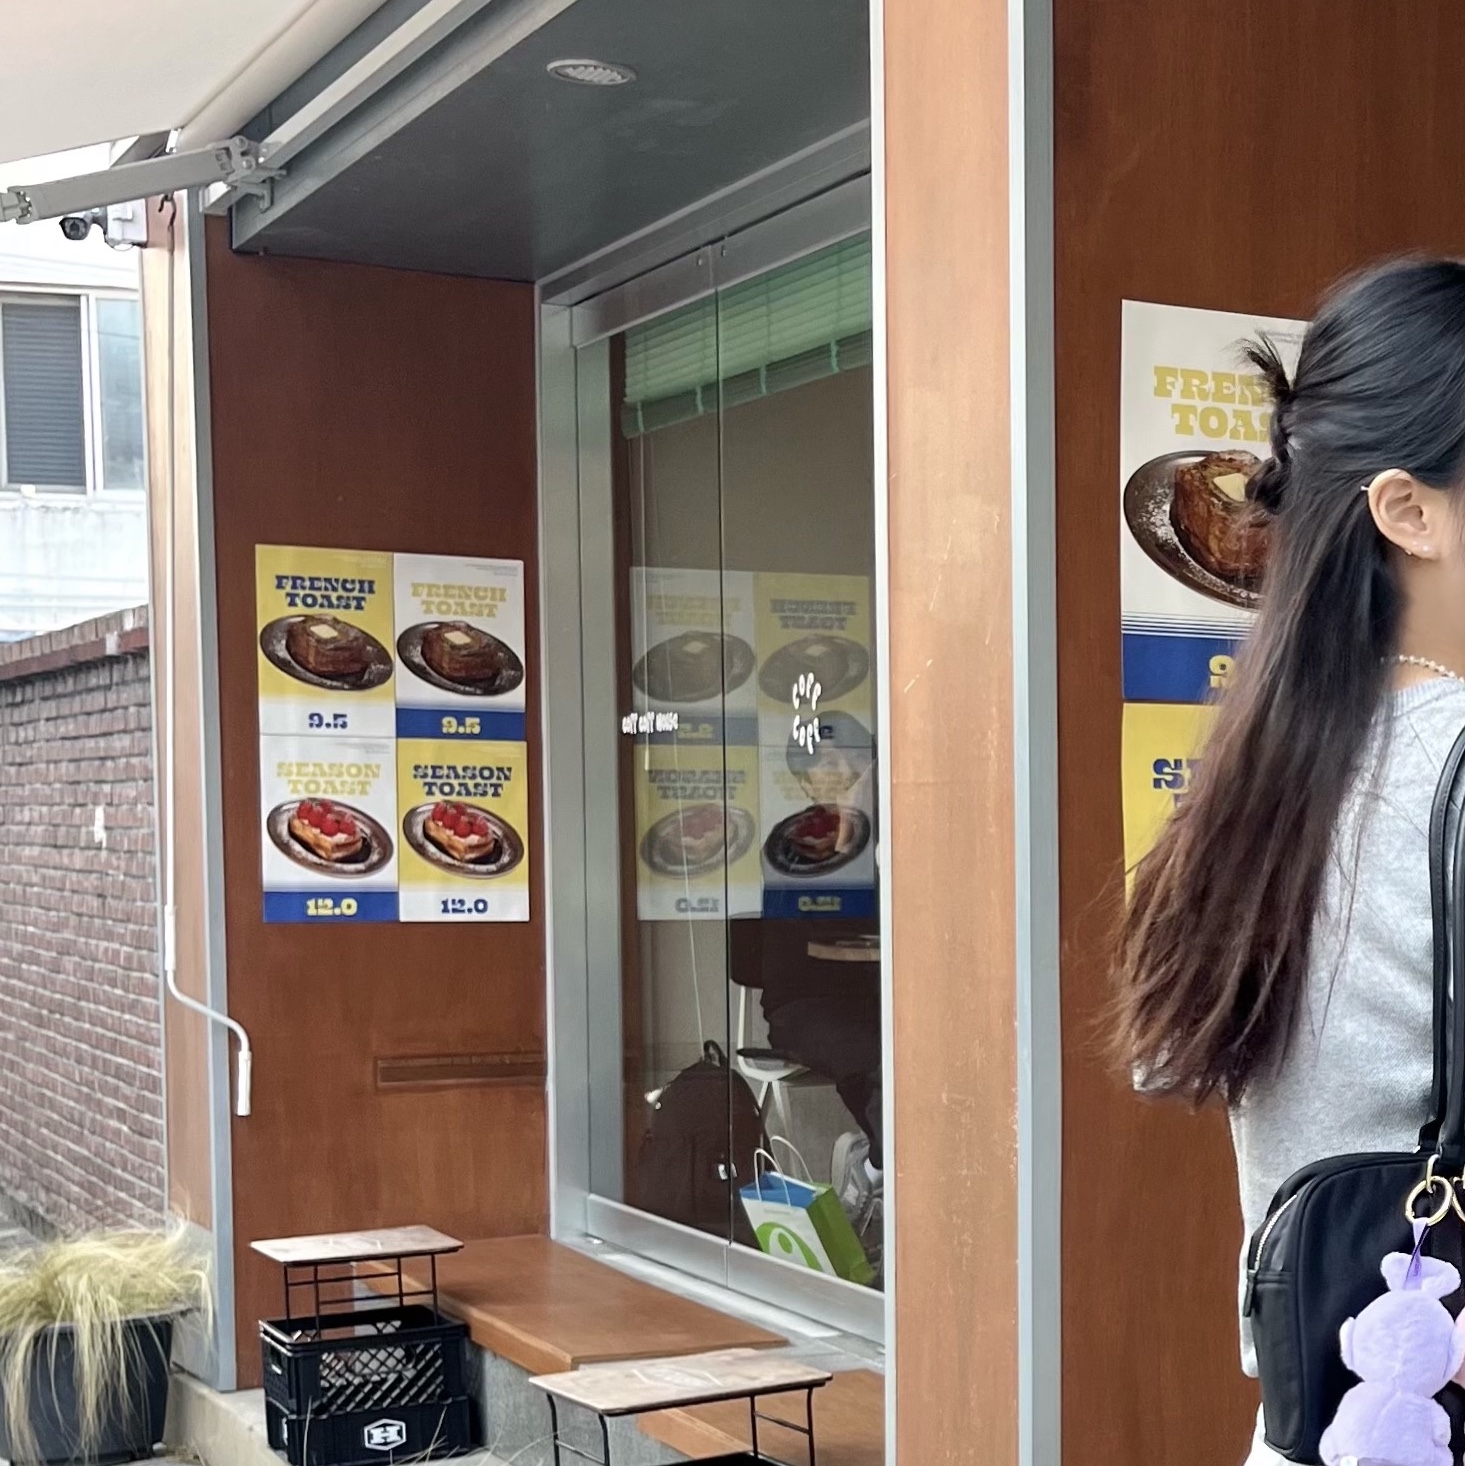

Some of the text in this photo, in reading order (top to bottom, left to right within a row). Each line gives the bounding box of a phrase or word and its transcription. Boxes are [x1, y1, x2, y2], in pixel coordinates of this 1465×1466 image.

[1153, 365, 1266, 407] FREN
[1170, 403, 1268, 442] TOA
[275, 575, 375, 594] FRENCH
[411, 582, 507, 602] FRENCH
[285, 593, 366, 610] TOAST
[420, 600, 498, 618] TOAST
[308, 713, 348, 729] 9.5
[441, 717, 481, 734] 9.5
[276, 762, 381, 779] SEASON
[413, 765, 512, 782] SEASON
[287, 779, 372, 797] TOAST
[423, 781, 503, 797] TOAST
[306, 897, 358, 916] 12.0
[441, 898, 489, 914] 12.0
